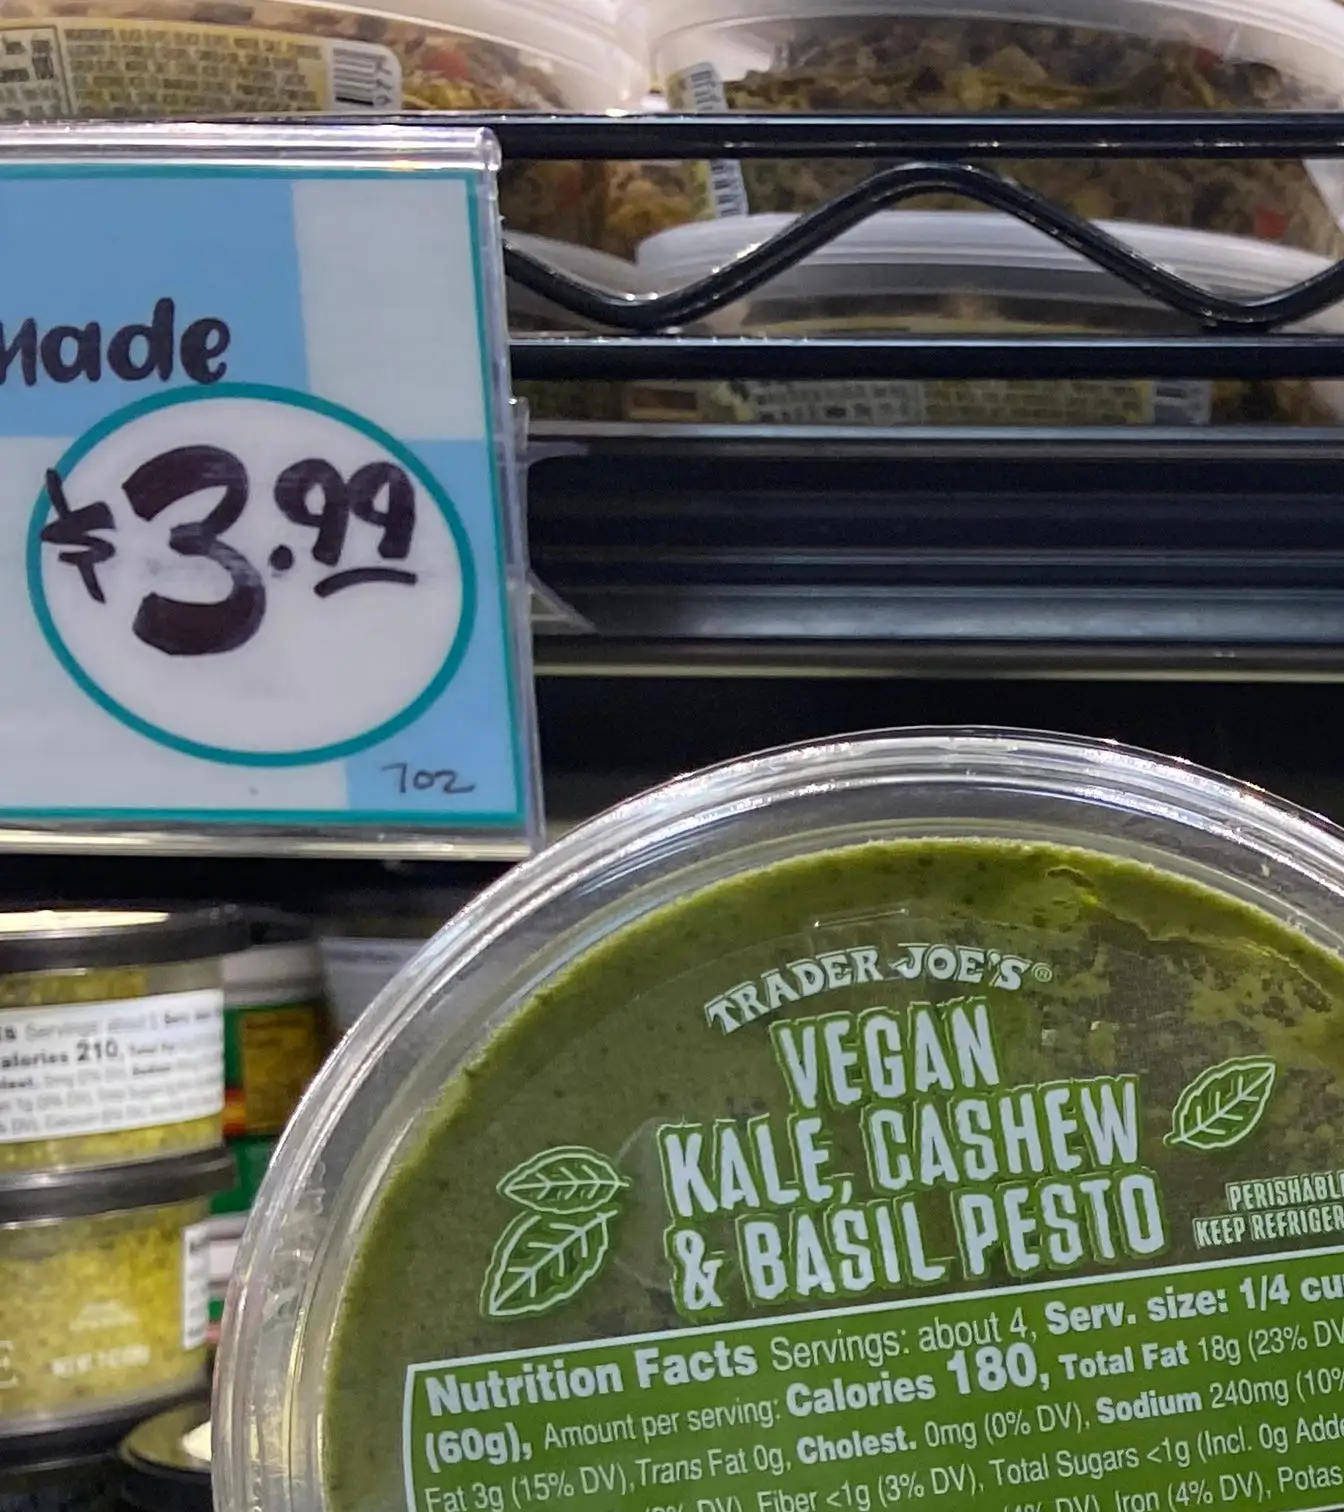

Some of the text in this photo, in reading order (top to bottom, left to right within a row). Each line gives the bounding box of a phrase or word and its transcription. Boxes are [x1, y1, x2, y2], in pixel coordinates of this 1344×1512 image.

[706, 946, 882, 1036] TRADER
[776, 1000, 1001, 1107] VEGAN
[661, 1079, 1141, 1214] KALE, CASHEW
[673, 1170, 1167, 1311] & BASIL PESTO
[1194, 1218, 1246, 1249] KEEP
[424, 1422, 533, 1472] (60g),
[543, 1416, 636, 1451] Amount
[642, 1412, 679, 1448] per
[686, 1397, 781, 1432] serving:
[785, 1370, 935, 1417] Calories
[947, 1342, 1050, 1395] 180,
[1058, 1348, 1135, 1381] Total
[1143, 1340, 1190, 1371] Fat
[1199, 1336, 1241, 1368] 18g
[1248, 1326, 1307, 1362] (23%
[425, 1359, 623, 1416] Nutrition
[635, 1342, 758, 1388] Facts
[771, 1328, 910, 1372] Servings:
[919, 1308, 1002, 1353] about
[1010, 1309, 1037, 1341] 4,
[1045, 1302, 1137, 1335] Serv.
[1148, 1286, 1228, 1322] size:
[1239, 1273, 1290, 1311] 1/4
